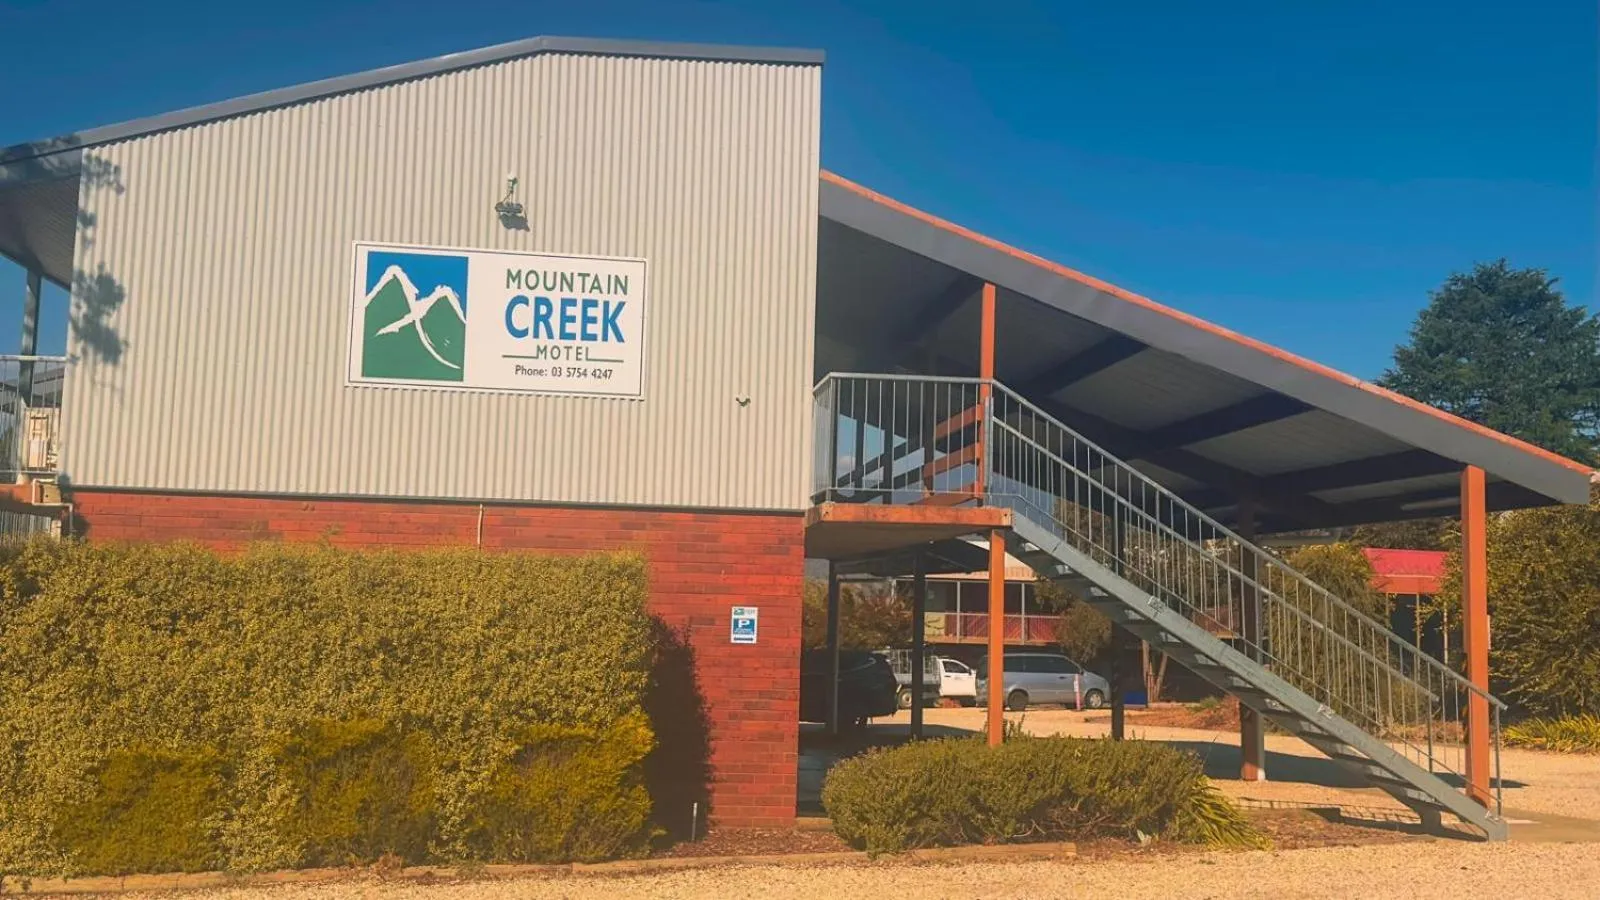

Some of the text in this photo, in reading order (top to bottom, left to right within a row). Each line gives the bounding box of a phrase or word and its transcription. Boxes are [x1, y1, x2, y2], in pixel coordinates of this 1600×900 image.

[506, 268, 629, 295] MOUNTAIN
[505, 295, 626, 343] CREEK
[536, 345, 590, 361] MOTEL
[515, 365, 613, 380] Phone: 03 5754 4247
[738, 619, 750, 628] P
